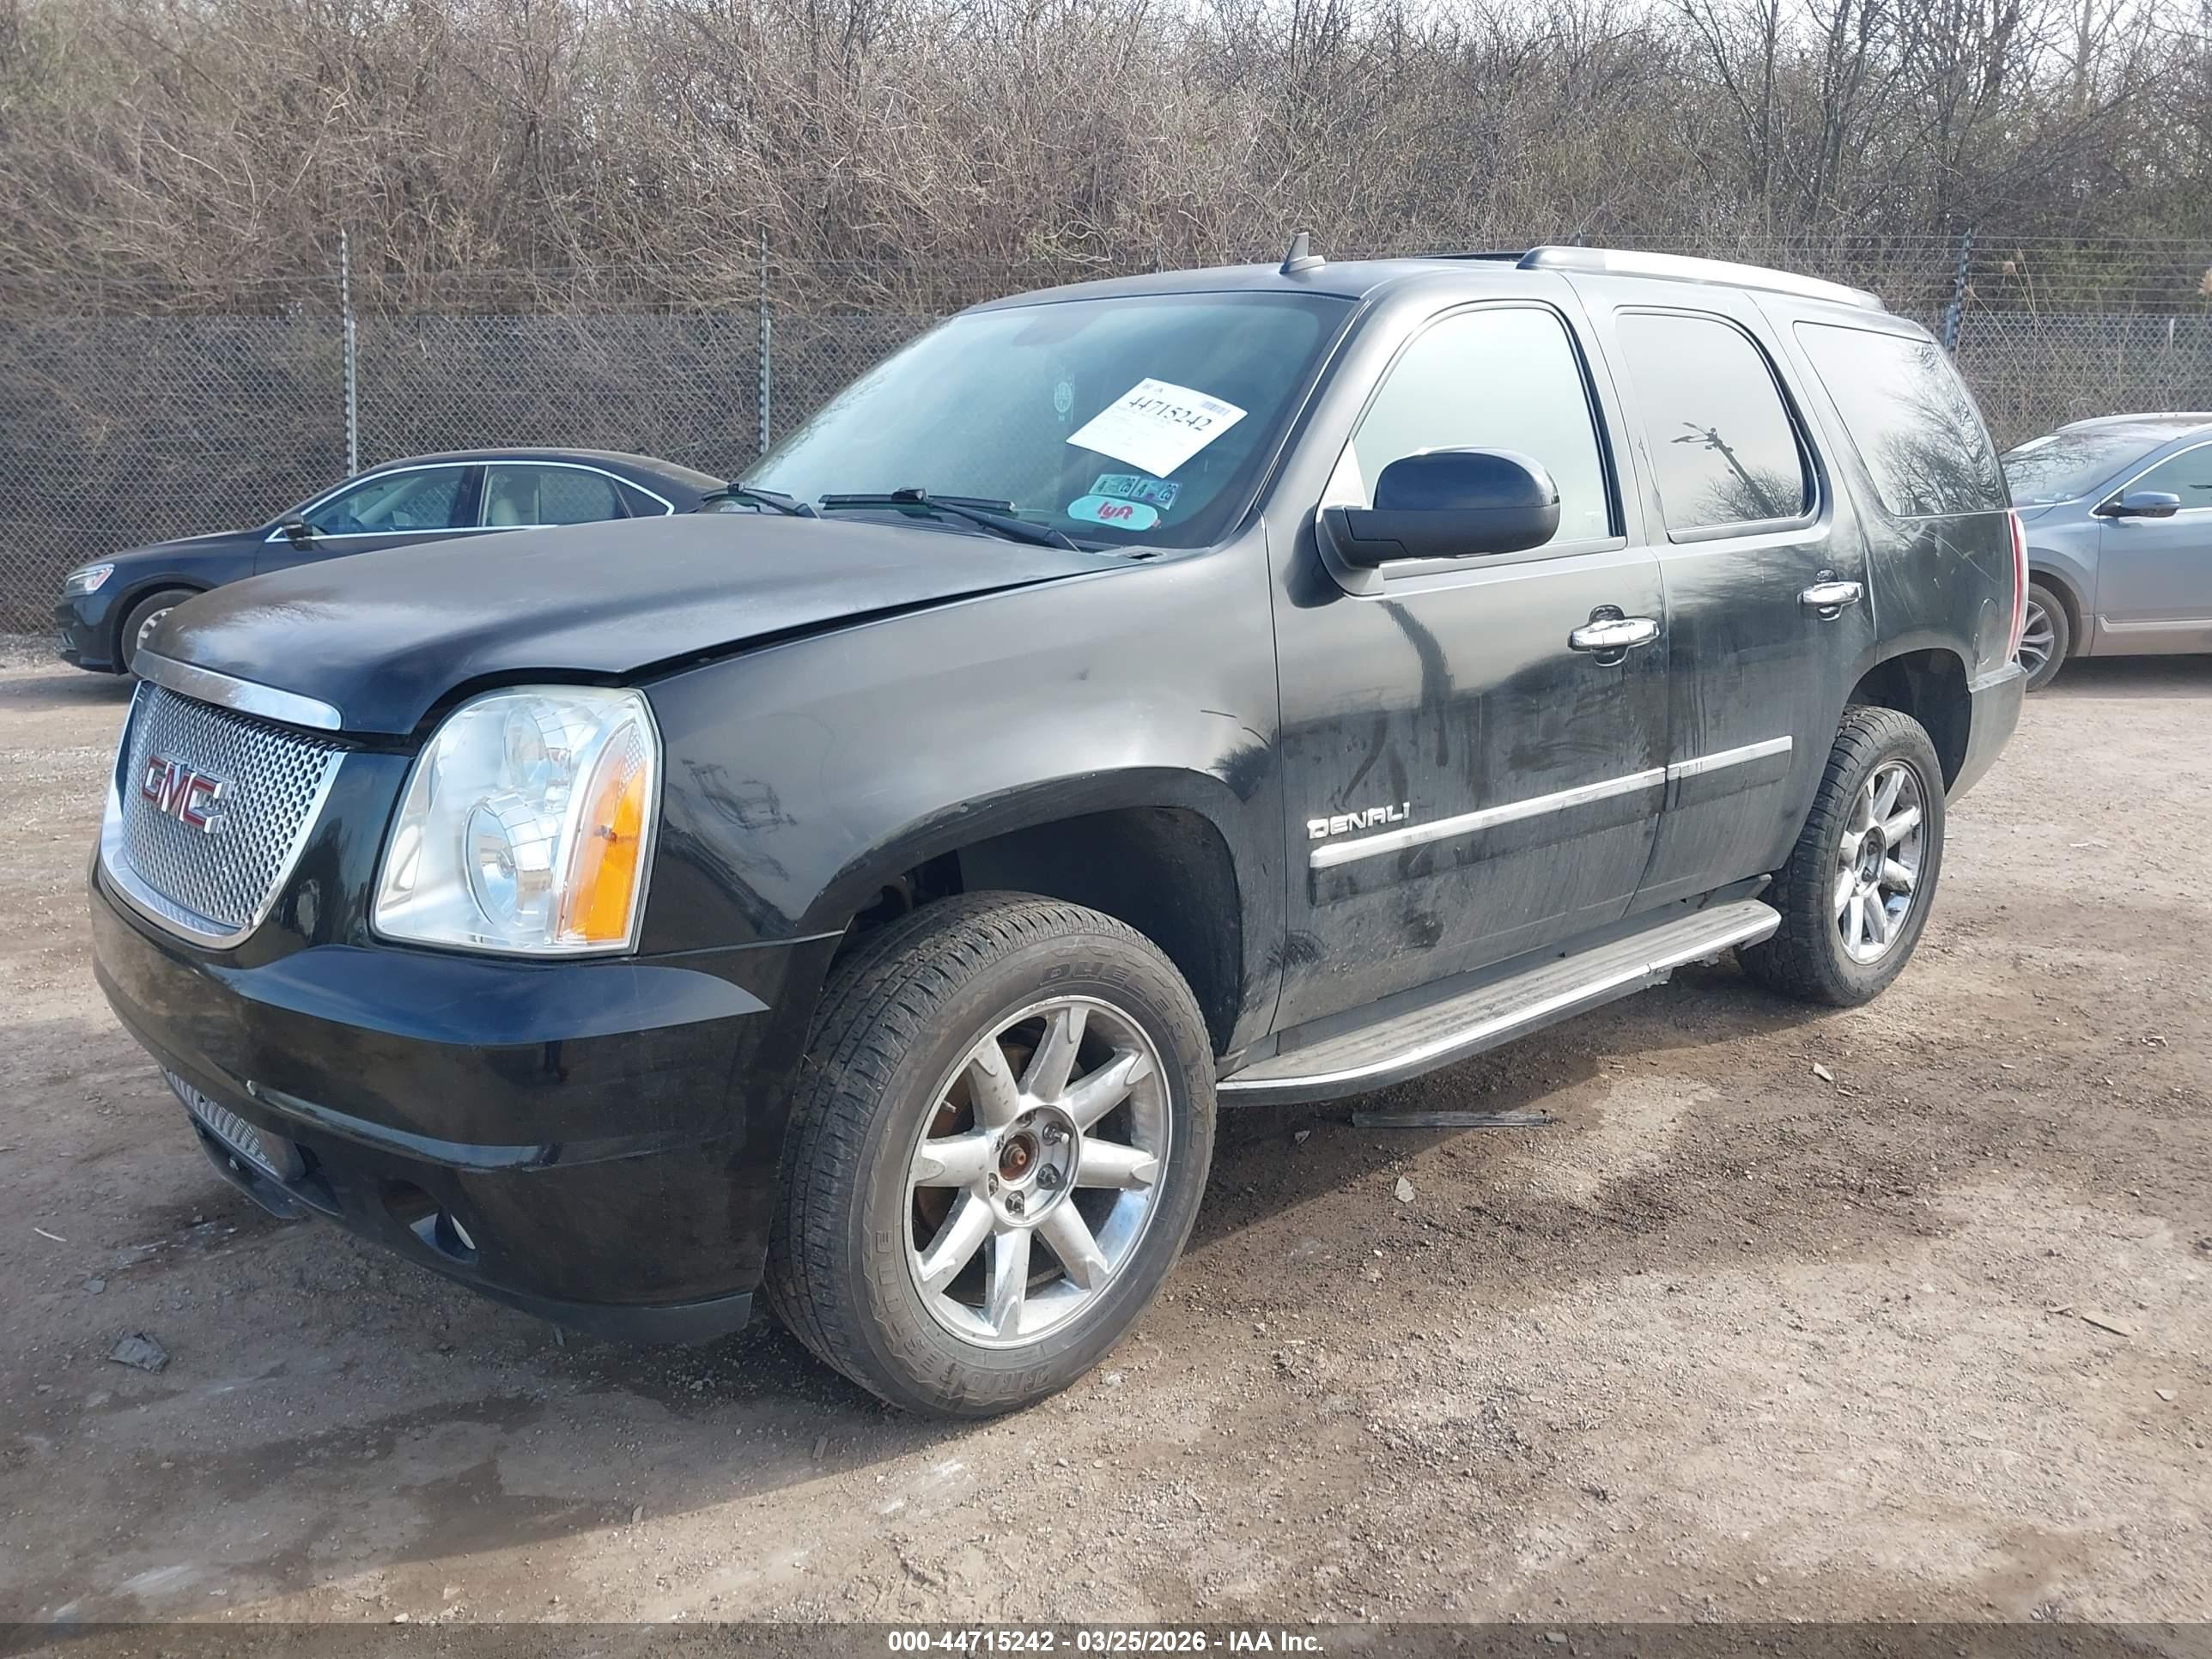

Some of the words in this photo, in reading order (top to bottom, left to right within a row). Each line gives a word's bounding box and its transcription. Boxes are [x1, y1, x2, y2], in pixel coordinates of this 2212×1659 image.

[1130, 397, 1212, 431] 44715242
[142, 751, 231, 834] GMC
[1306, 801, 1411, 839] DENALI
